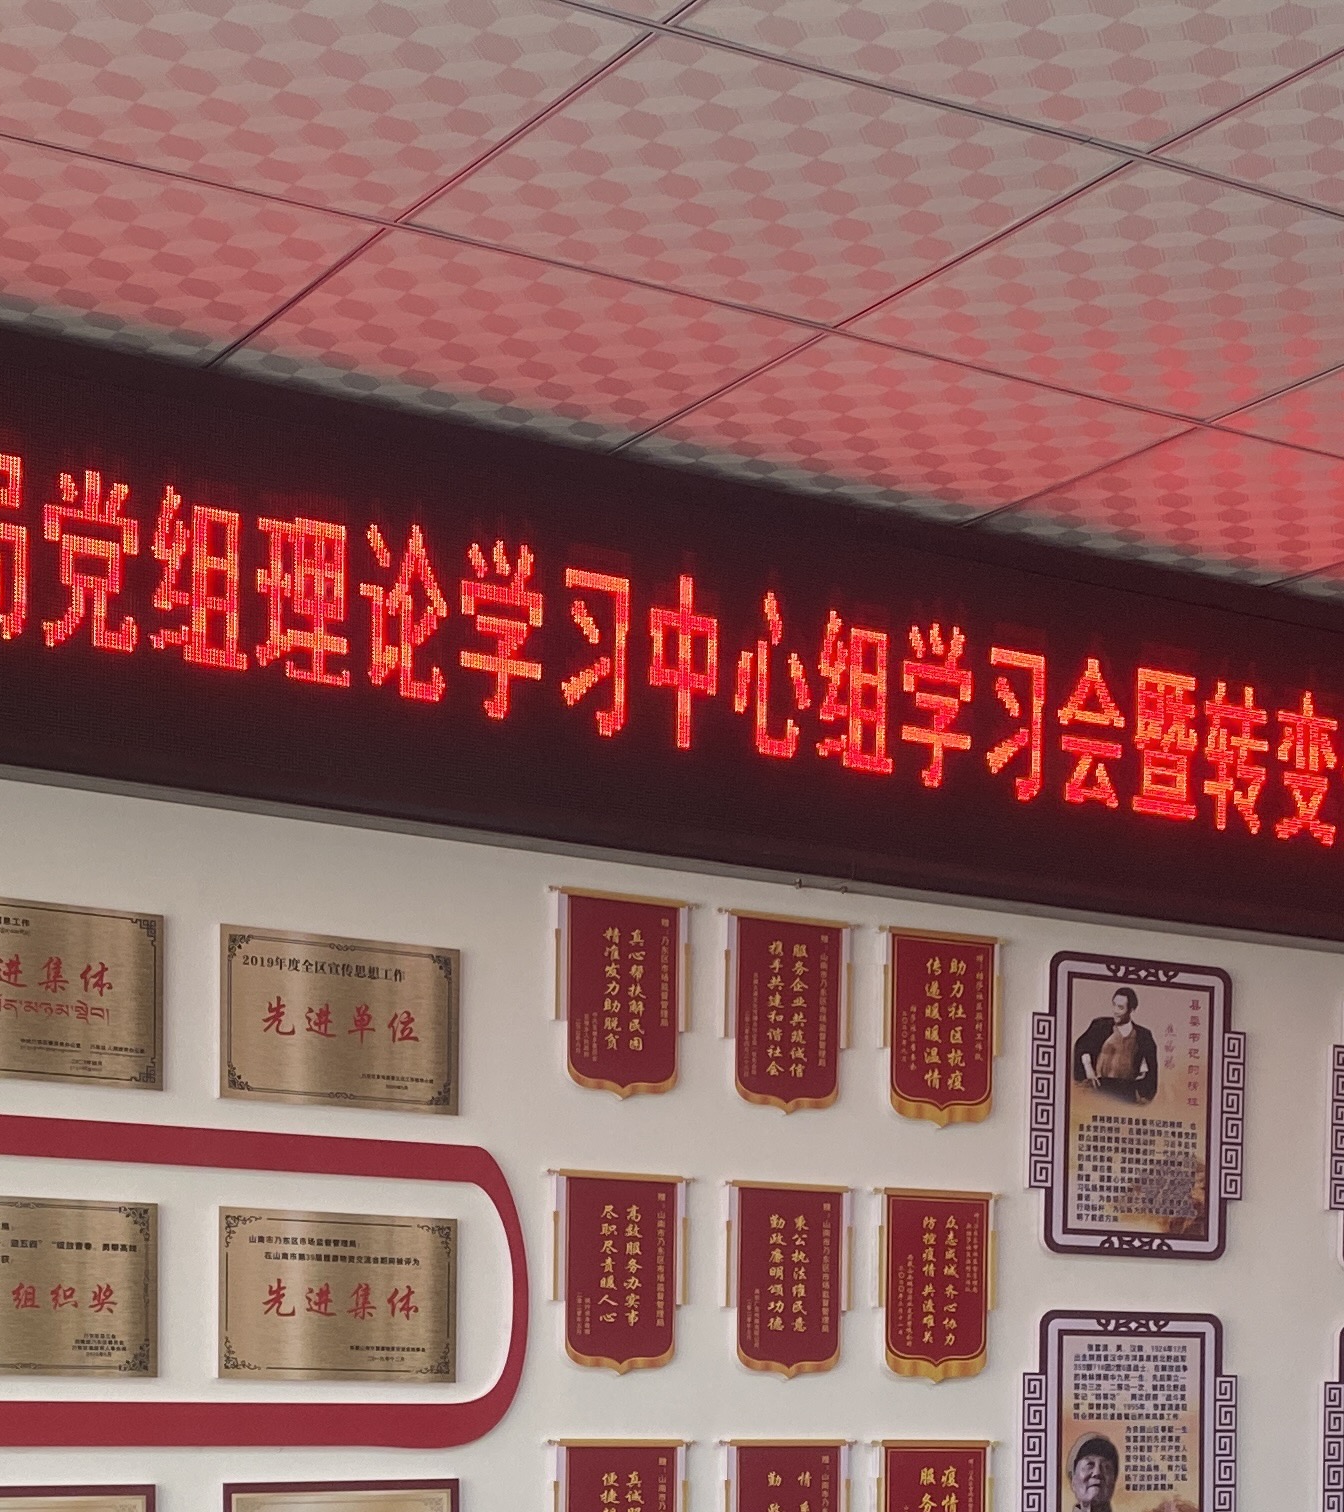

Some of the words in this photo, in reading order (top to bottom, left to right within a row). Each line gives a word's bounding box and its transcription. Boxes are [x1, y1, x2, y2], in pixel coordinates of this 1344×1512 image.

[242, 954, 405, 982] 2019年度全区宣传思想工作
[261, 995, 420, 1044] 先进单位
[603, 926, 622, 1051] 精准发力助脱贫
[627, 929, 646, 1052] 真心帮扶解民困
[765, 939, 785, 1078] 携手共建和谐社会
[789, 943, 809, 1078] 服务企业共筑诚信
[923, 956, 943, 1091] 传递暖暖温情
[947, 957, 967, 1092] 助力社区抗疫
[262, 1278, 419, 1320] 先进集体
[598, 1204, 618, 1324] 尽职尽责暖人心
[623, 1205, 643, 1327] 高效服务办实事
[767, 1214, 787, 1331] 勤政廉明颂功德
[791, 1214, 809, 1332] 秉公执法维民意
